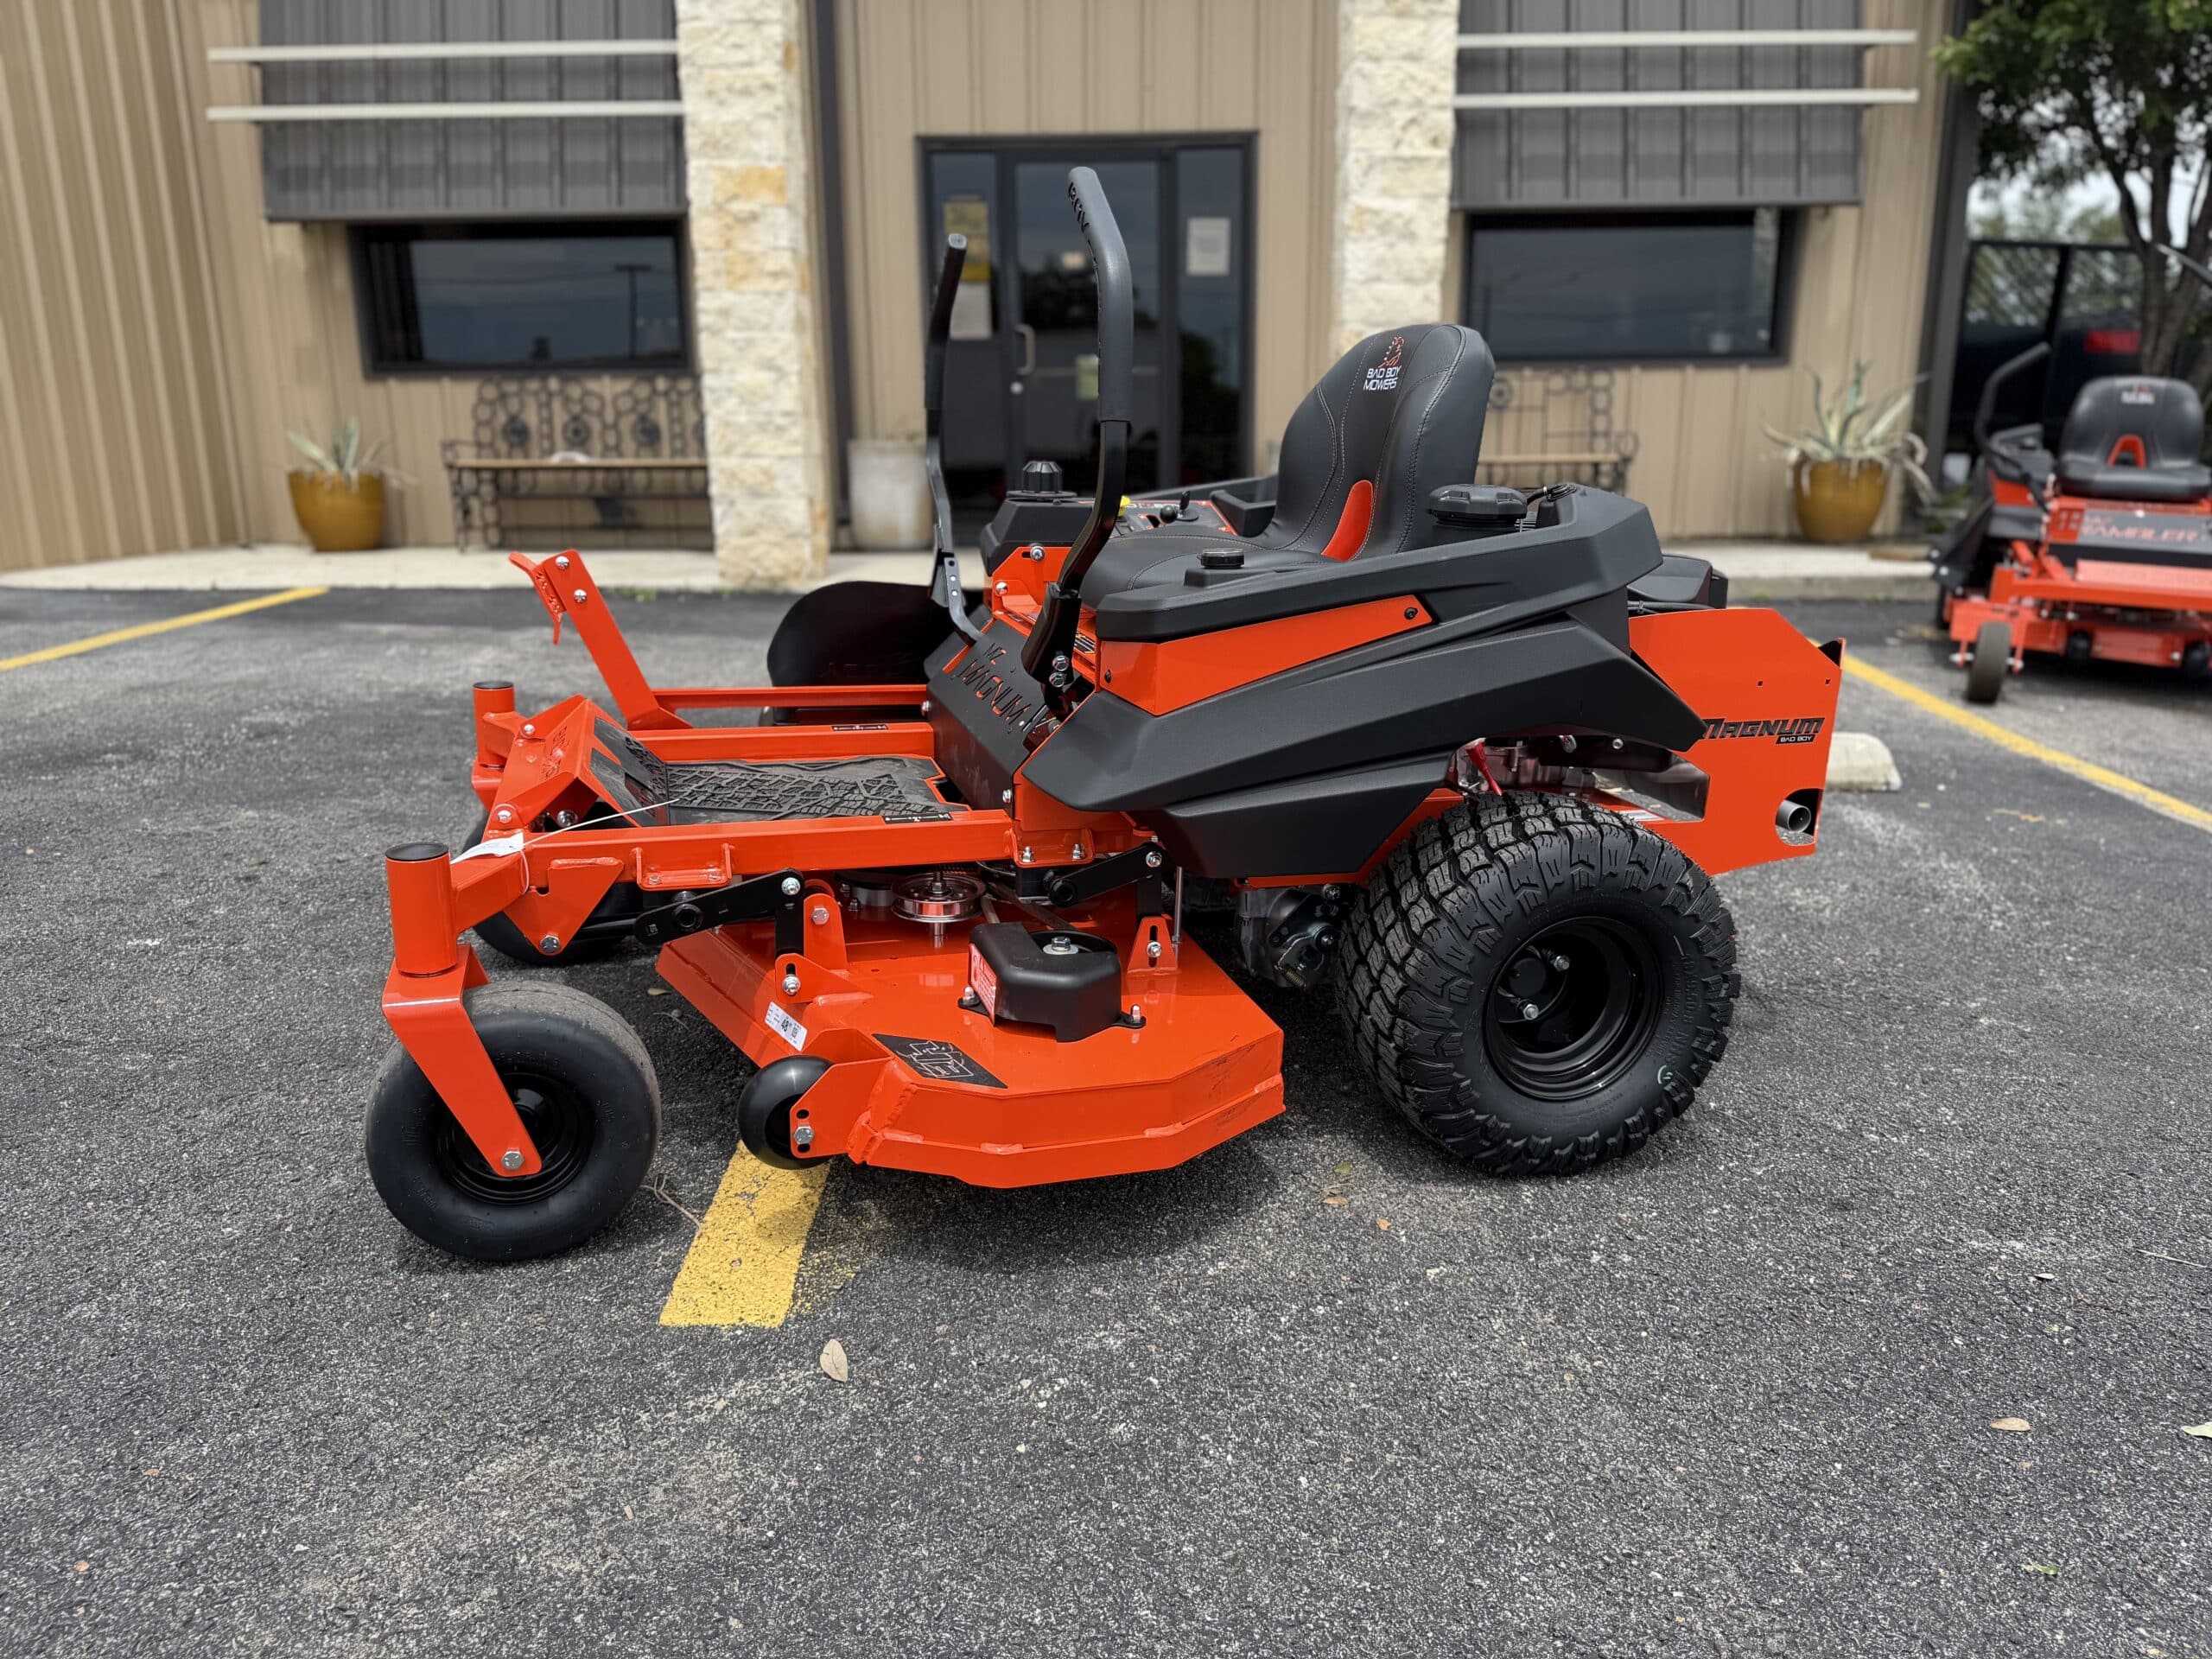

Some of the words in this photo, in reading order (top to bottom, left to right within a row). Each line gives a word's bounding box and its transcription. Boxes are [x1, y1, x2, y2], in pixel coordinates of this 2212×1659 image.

[1367, 368, 1384, 378] BAD
[1385, 365, 1402, 378] BOY
[957, 658, 1032, 725] MAGNUM
